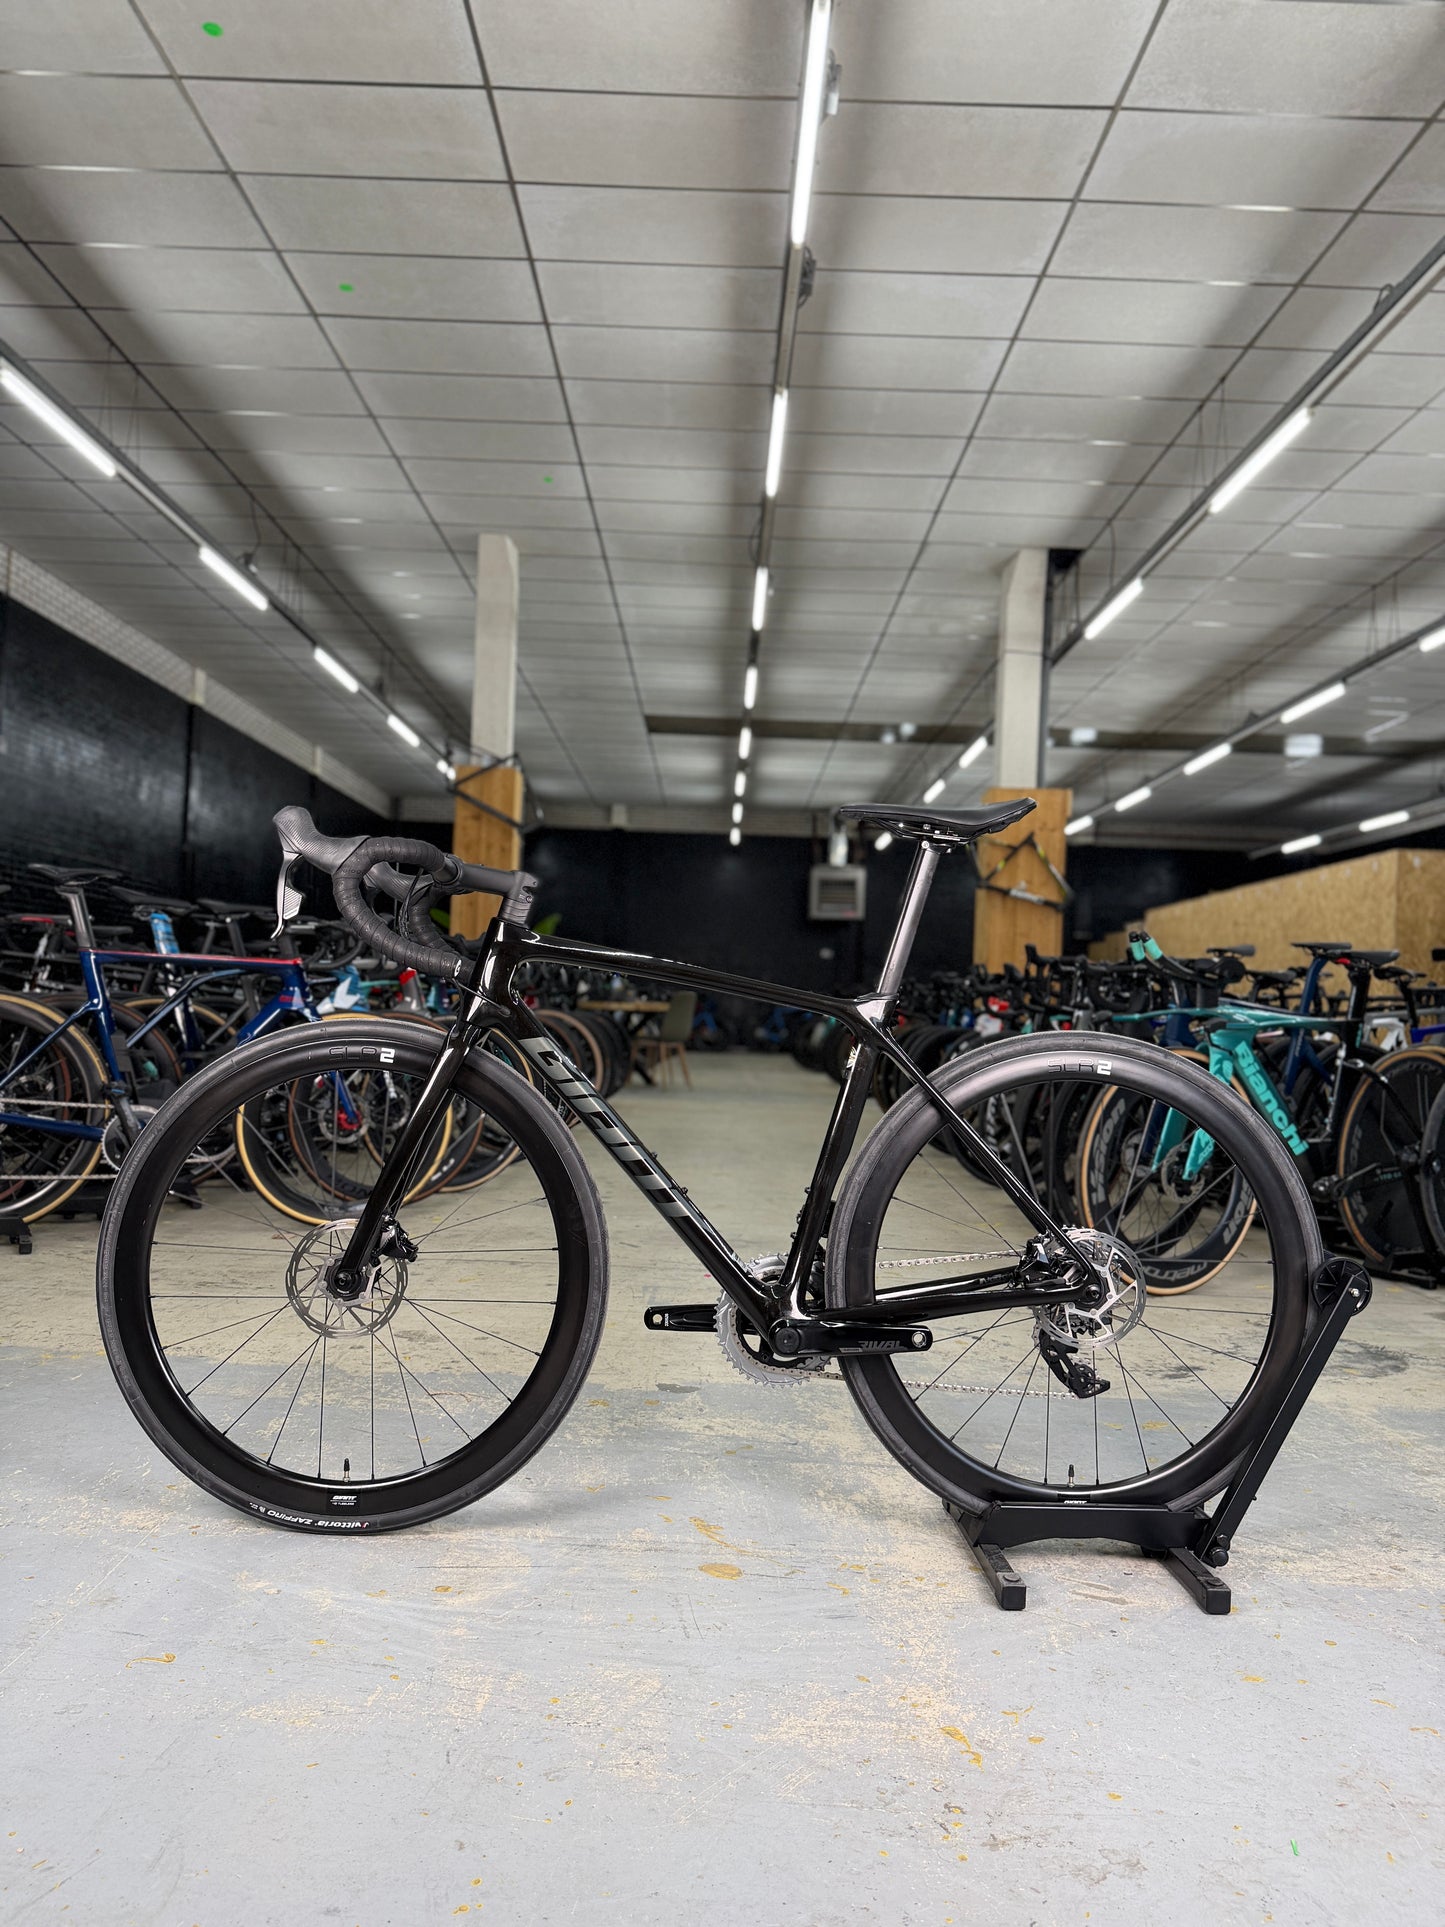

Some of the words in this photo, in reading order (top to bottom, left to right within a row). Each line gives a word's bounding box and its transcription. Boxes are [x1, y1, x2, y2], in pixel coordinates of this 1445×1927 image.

[1234, 1040, 1309, 1156] Bianchi
[518, 1037, 714, 1235] GIANT
[858, 1340, 908, 1352] RIVAL
[266, 1509, 313, 1525] ZAFFIRO
[317, 1520, 361, 1529] vittoria
